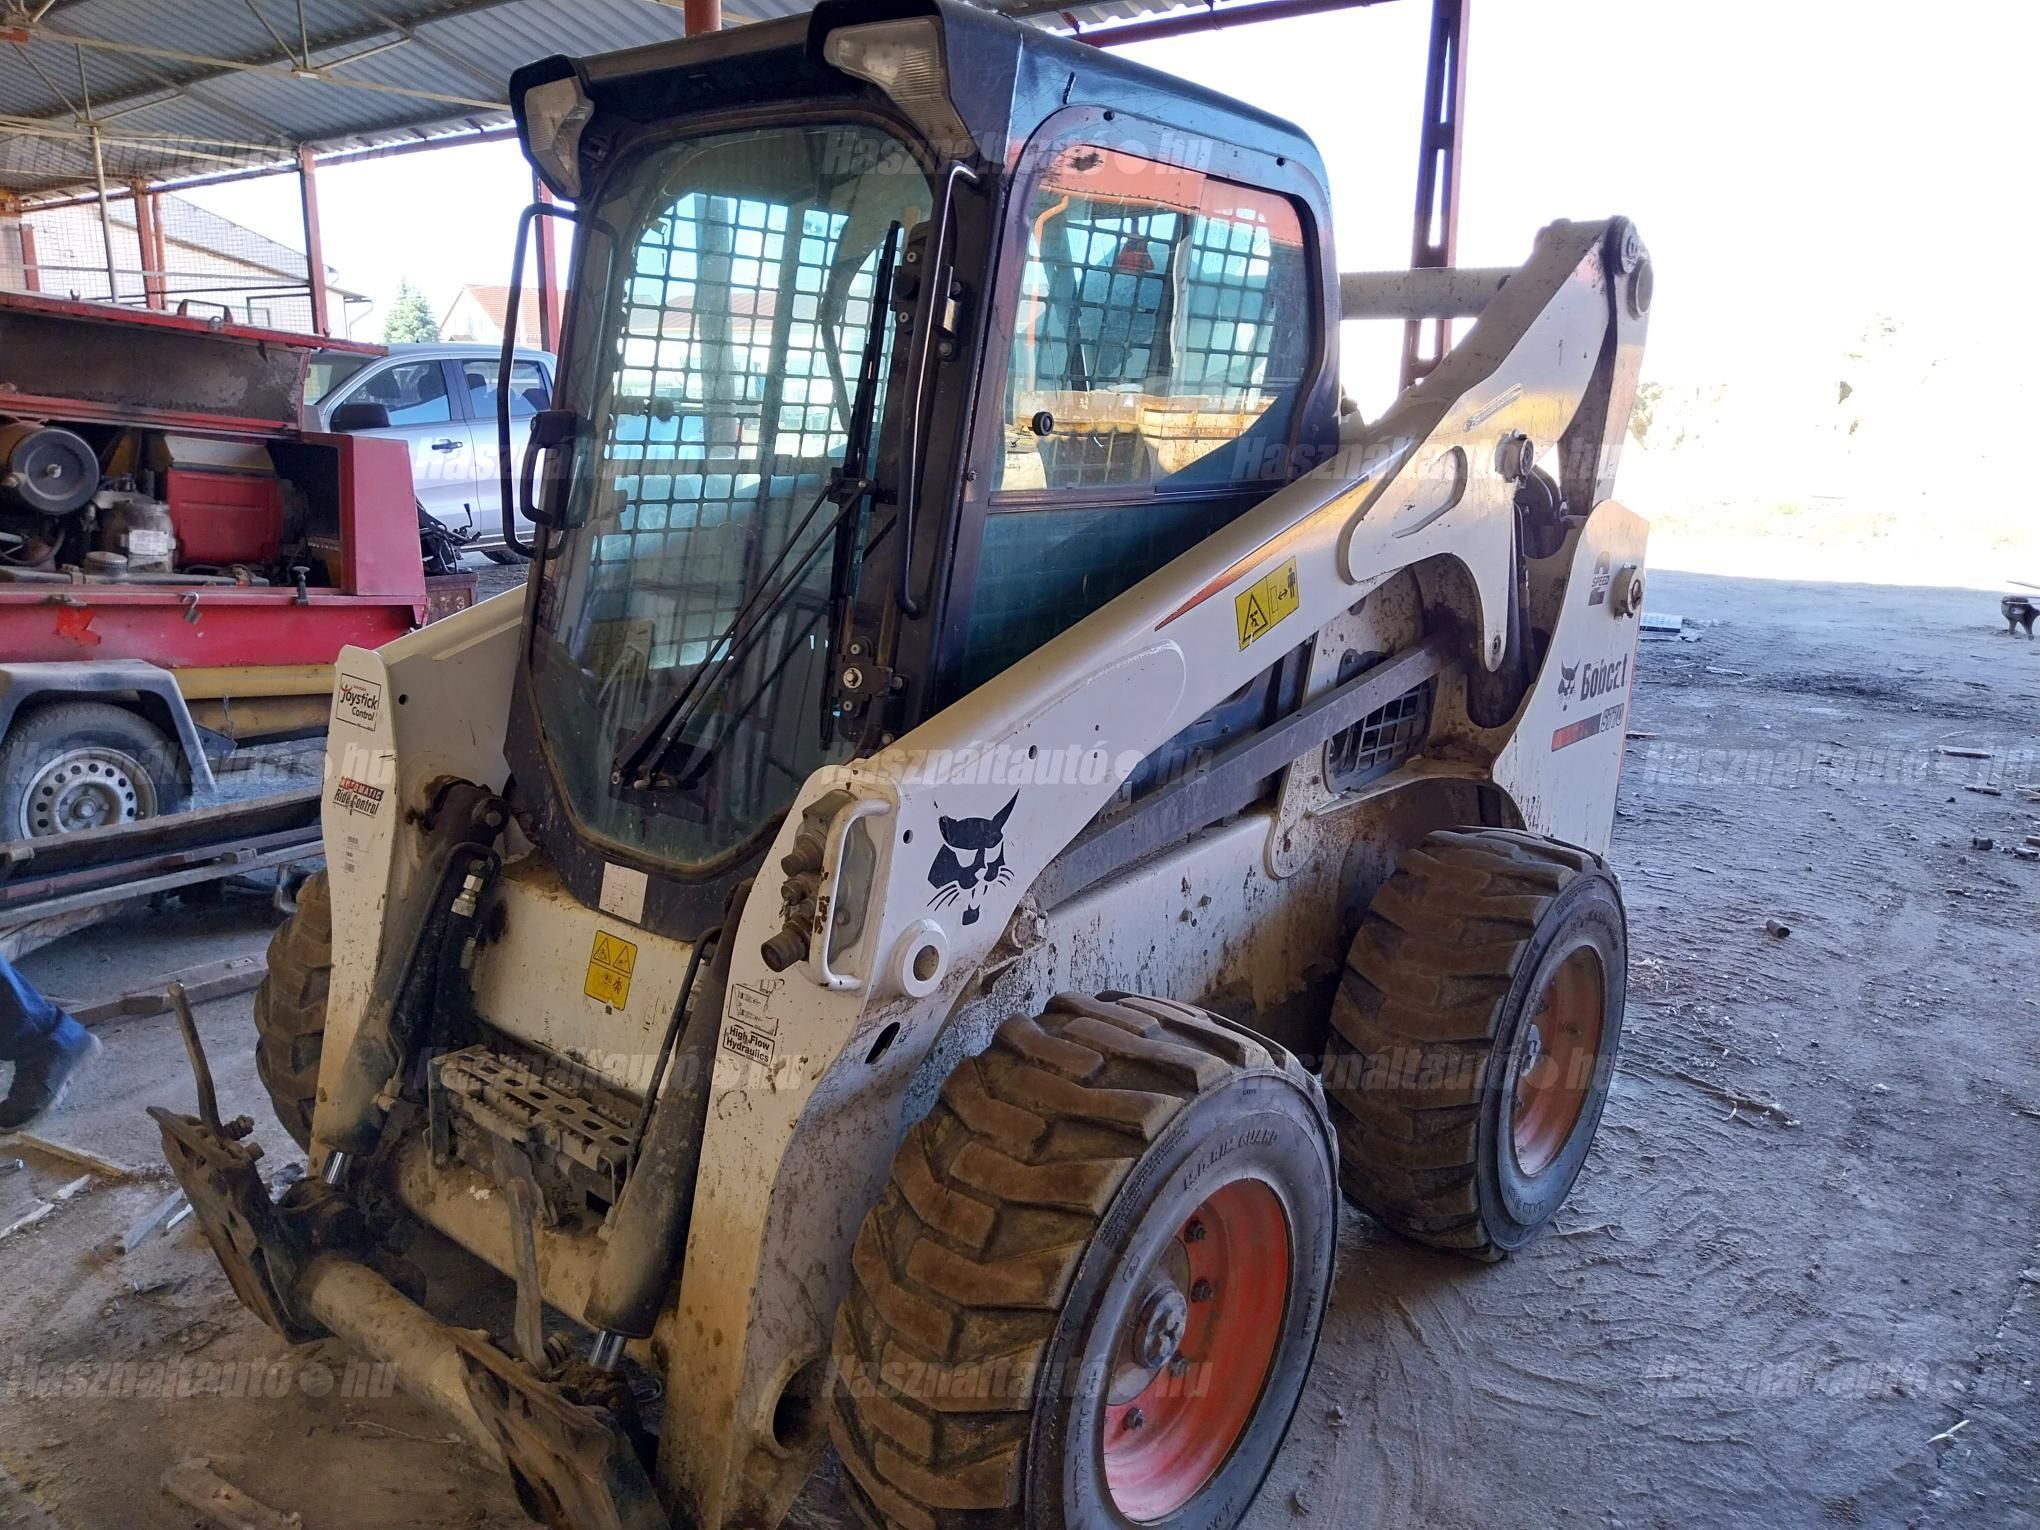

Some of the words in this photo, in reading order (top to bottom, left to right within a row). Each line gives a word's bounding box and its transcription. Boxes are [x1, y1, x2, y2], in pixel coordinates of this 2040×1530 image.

[1579, 652, 1628, 702] Bobcat
[352, 706, 375, 721] Control
[334, 788, 351, 804] Ride
[352, 794, 380, 815] Control
[341, 779, 382, 799] AUTOMATIC
[726, 1036, 770, 1063] Hydraulics
[729, 1025, 748, 1043] High
[749, 1034, 771, 1050] Flow
